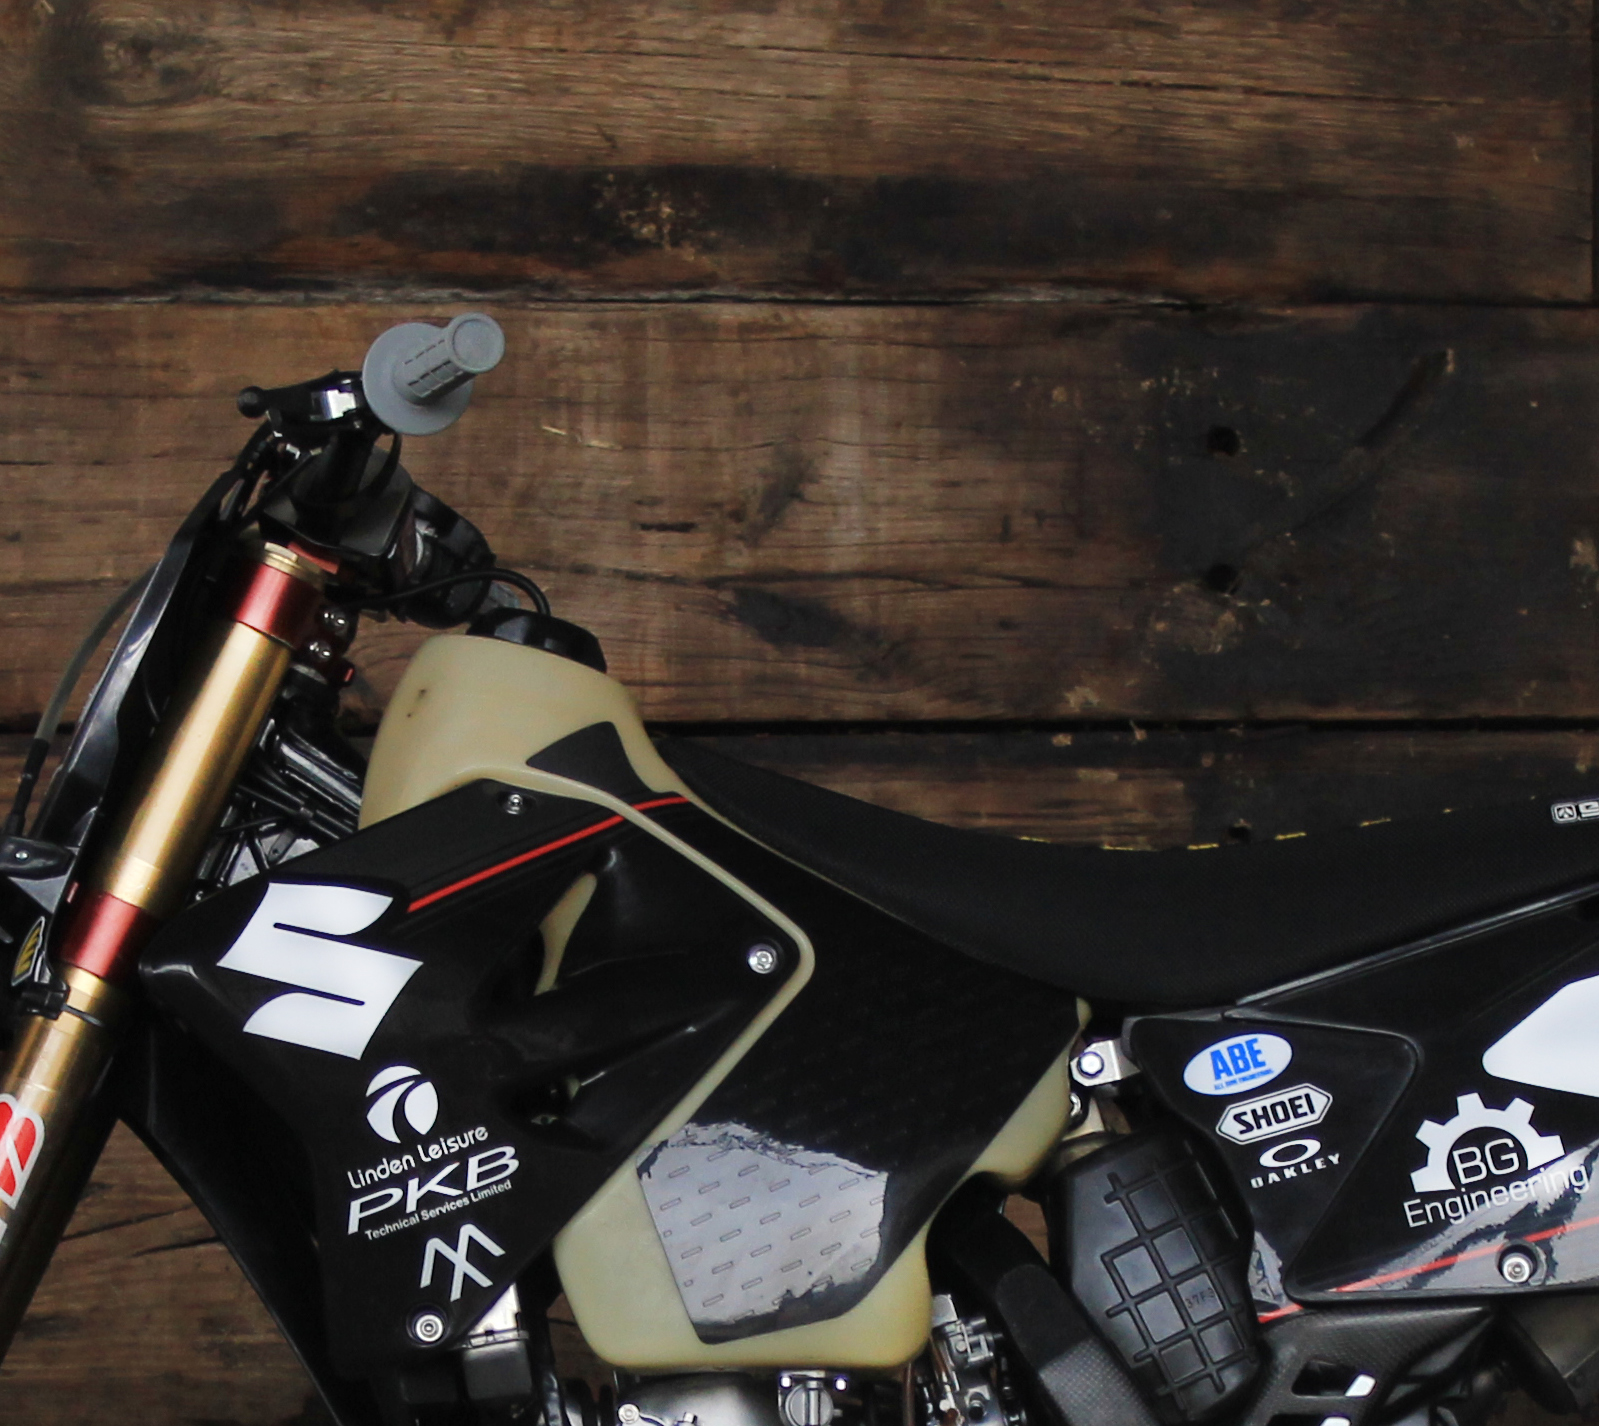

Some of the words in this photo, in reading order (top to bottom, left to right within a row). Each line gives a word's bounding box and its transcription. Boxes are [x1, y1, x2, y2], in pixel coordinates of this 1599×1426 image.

[1210, 1038, 1267, 1081] ABE
[1233, 1093, 1316, 1135] SHOEI
[347, 1154, 416, 1189] Linden
[417, 1125, 489, 1162] Leisure
[1250, 1153, 1341, 1189] OAKLEY
[1452, 1137, 1521, 1185] BG
[348, 1145, 520, 1235] PKB
[365, 1213, 420, 1240] Technical
[421, 1195, 470, 1222] Services
[470, 1179, 512, 1203] Limited
[1403, 1163, 1592, 1228] Engineering
